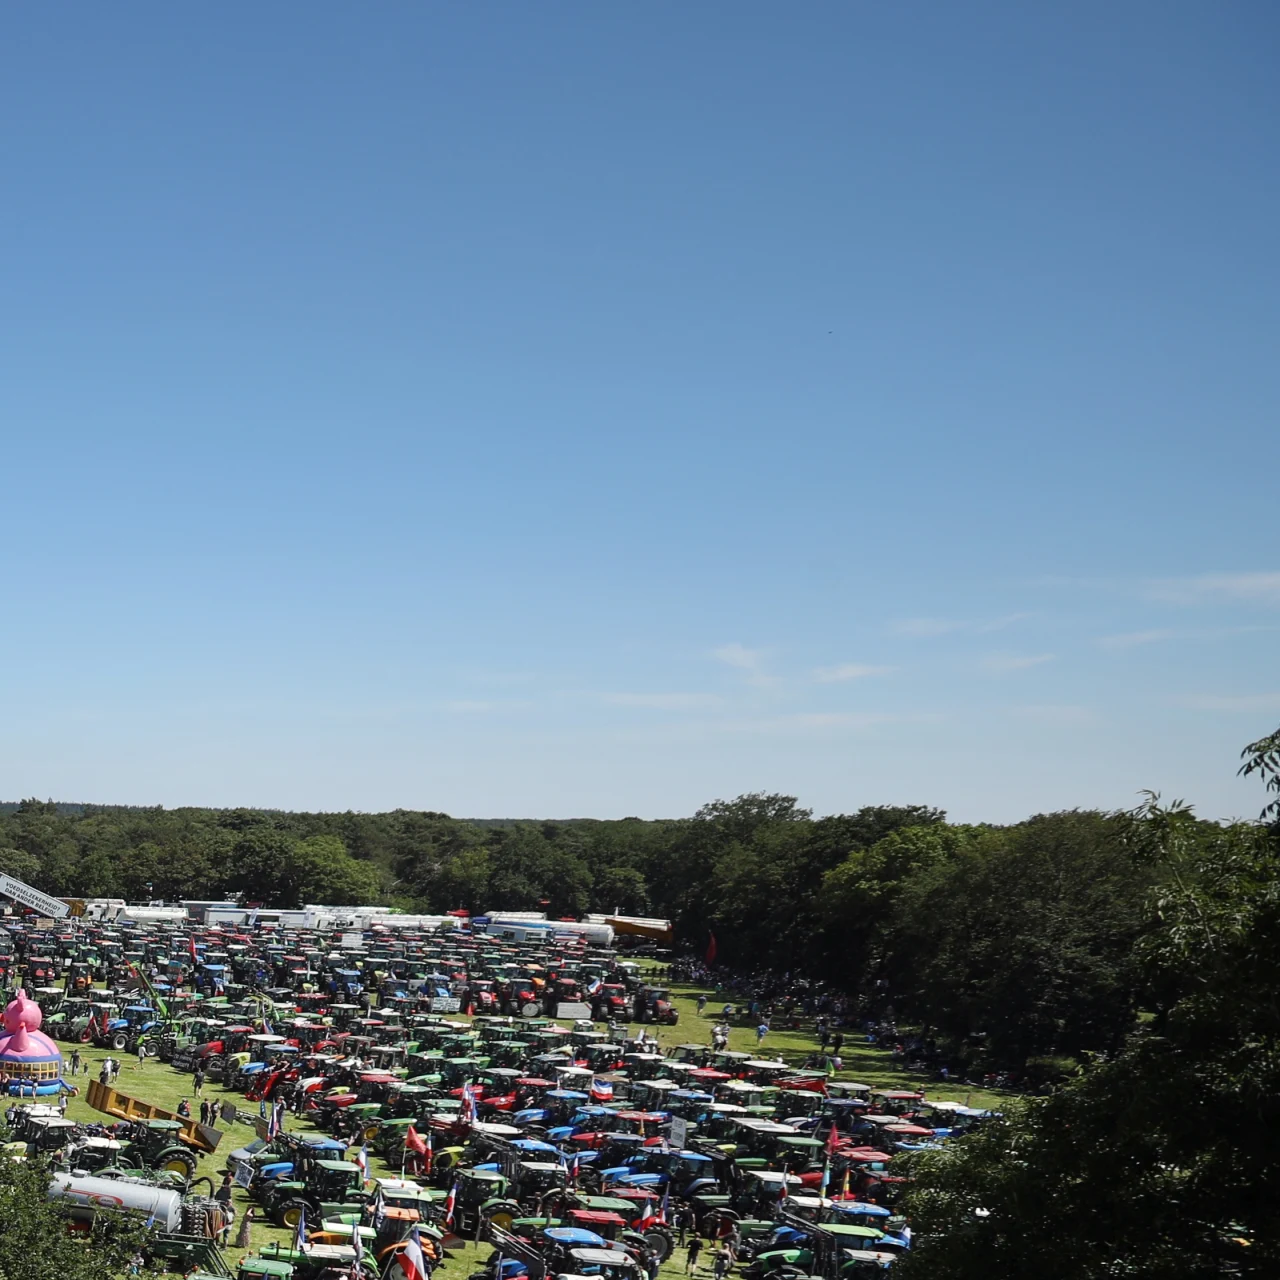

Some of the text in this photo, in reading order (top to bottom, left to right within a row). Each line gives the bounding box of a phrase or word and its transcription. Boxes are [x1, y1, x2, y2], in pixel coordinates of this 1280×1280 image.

[4, 887, 56, 916] DAN ANDER BELEID!
[5, 881, 61, 912] VOEDSELZEKERHEID?
